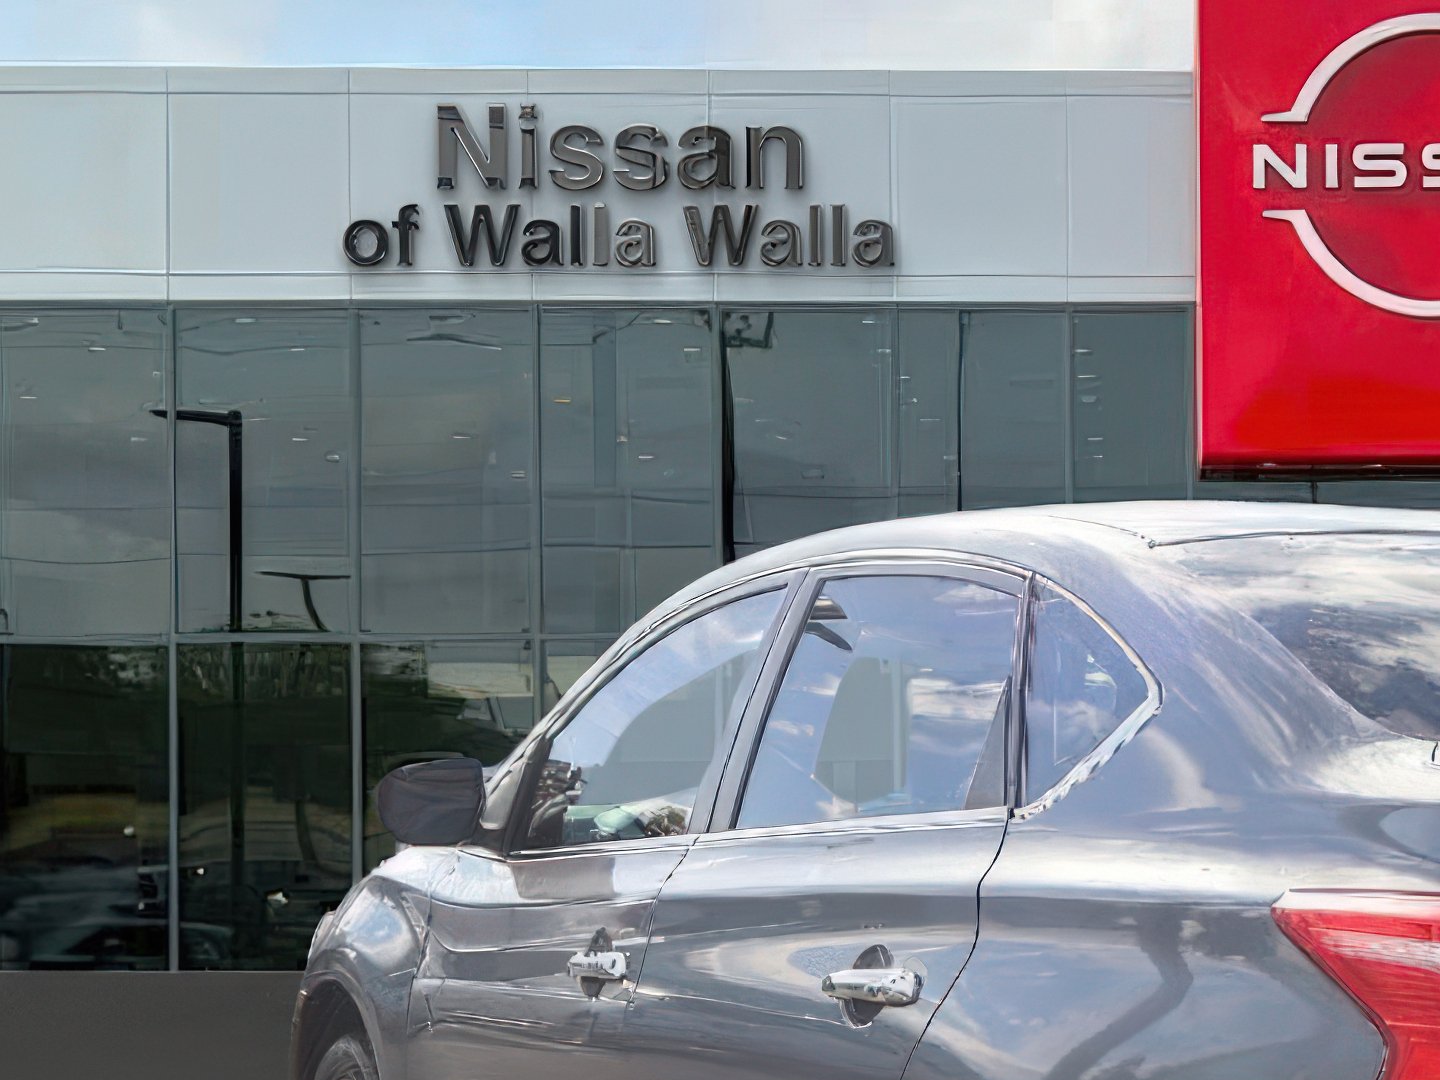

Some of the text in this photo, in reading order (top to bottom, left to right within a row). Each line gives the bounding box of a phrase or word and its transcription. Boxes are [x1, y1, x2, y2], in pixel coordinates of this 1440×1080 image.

[436, 103, 804, 191] Nissan
[342, 203, 895, 267] of Walla Walla
